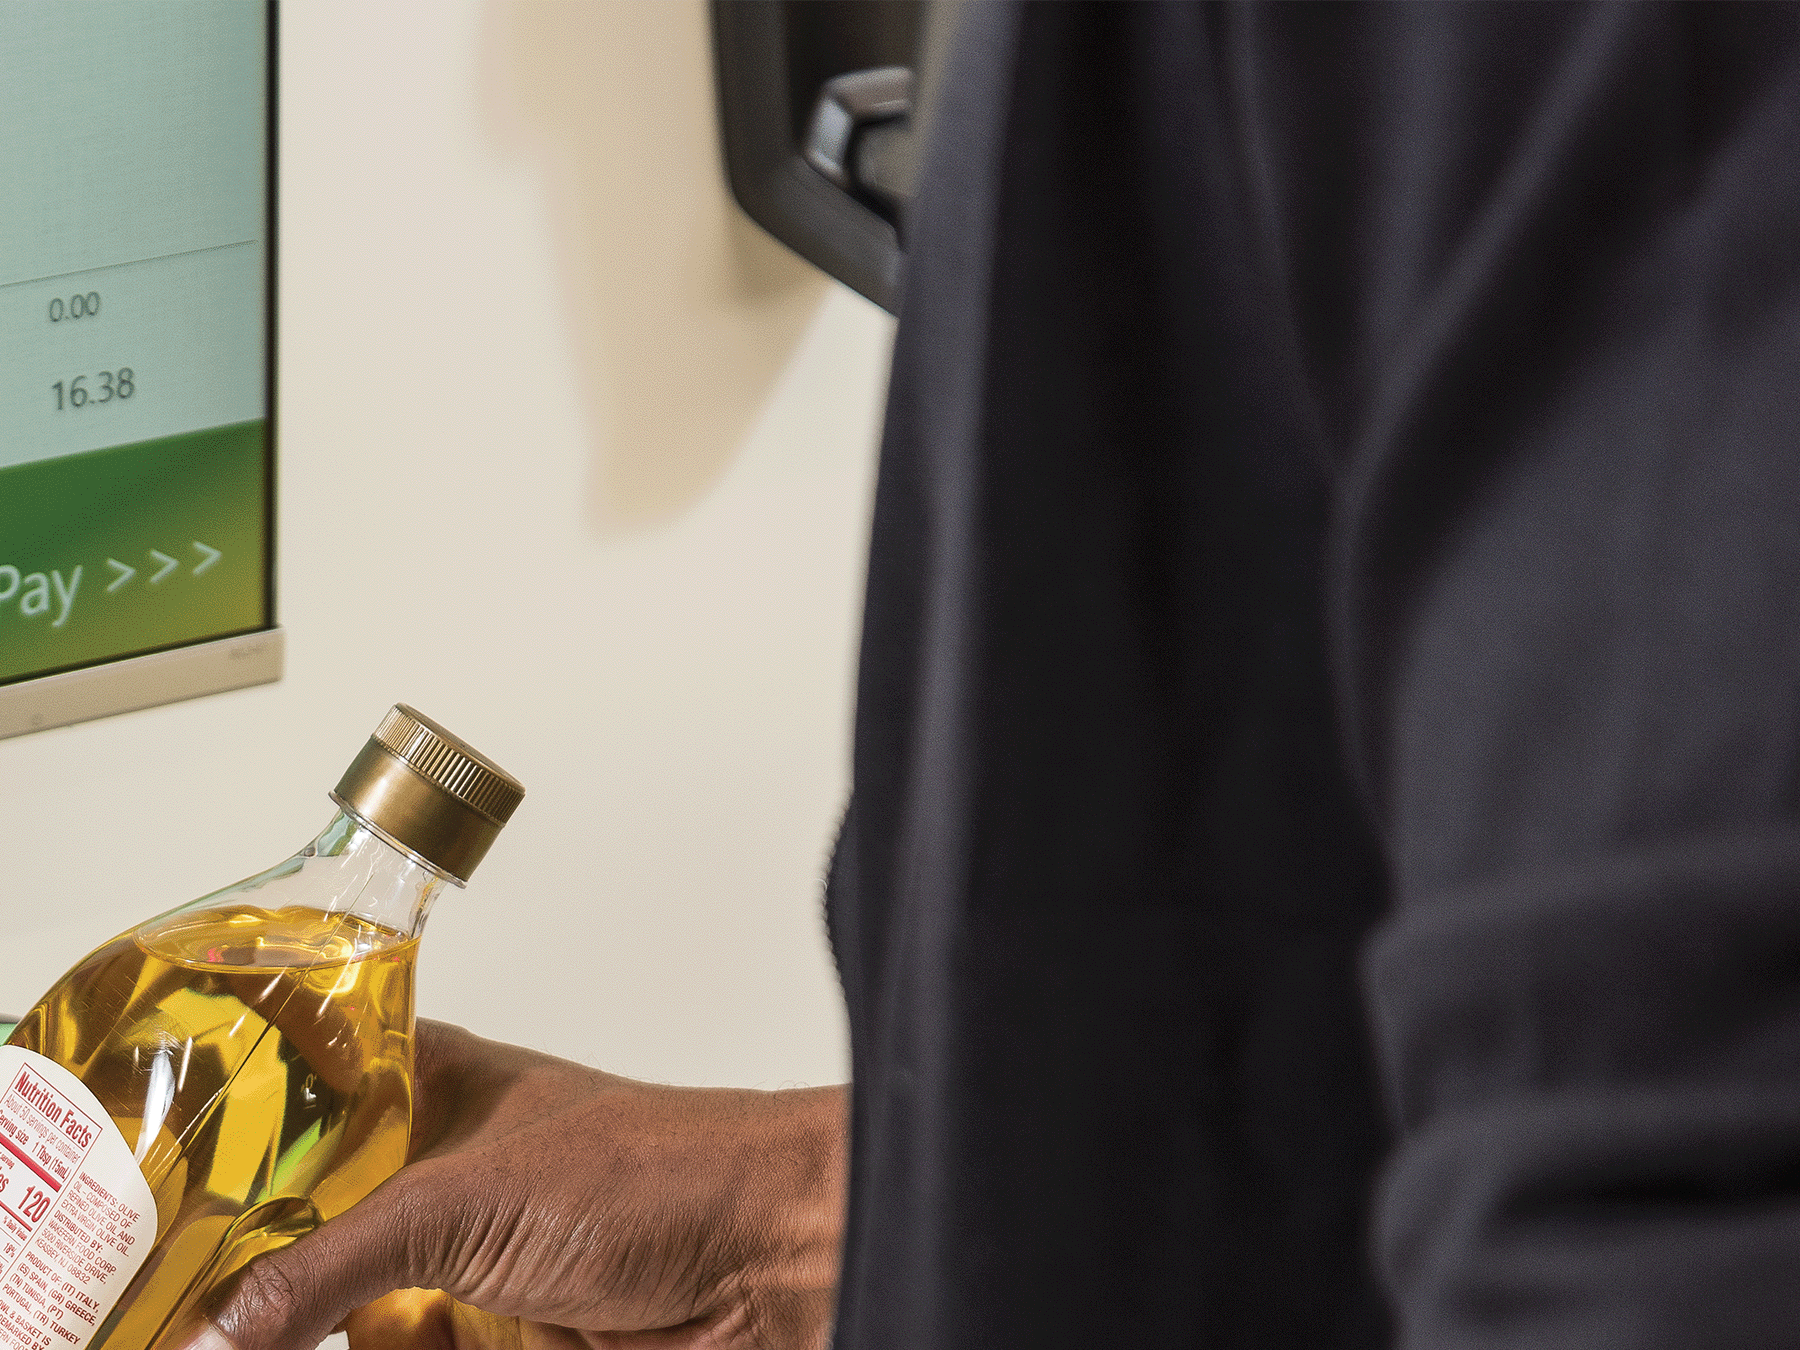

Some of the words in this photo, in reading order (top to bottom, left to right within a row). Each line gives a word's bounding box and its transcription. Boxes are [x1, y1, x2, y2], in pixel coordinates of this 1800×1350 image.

[48, 292, 101, 323] 0.00
[52, 367, 135, 412] 16.38
[4, 1093, 23, 1115] About
[18, 1105, 30, 1121] 50
[25, 1113, 50, 1139] servings
[45, 1132, 58, 1146] per
[55, 1138, 81, 1164] container
[14, 1071, 63, 1123] Nutrition
[59, 1109, 93, 1148] Facts
[15, 1128, 30, 1145] size
[35, 1144, 53, 1166] Tbsp
[47, 1156, 72, 1183] (15mL)
[17, 1185, 51, 1223] 120
[78, 1171, 119, 1208] INGREDIENTS:
[118, 1202, 141, 1223] OLIVE
[85, 1192, 121, 1222] COMPOSED
[119, 1218, 133, 1230] OF
[2, 1241, 16, 1258] 18%
[47, 1219, 76, 1246] WAKEFERN
[75, 1241, 95, 1260] FOOD
[94, 1255, 117, 1276] CORP.
[53, 1210, 91, 1244] DISTRIBUTED
[90, 1239, 103, 1254] BY:
[95, 1227, 118, 1247] OLIVE
[116, 1242, 130, 1257] OIL.
[105, 1221, 118, 1235] OIL
[117, 1229, 136, 1246] AND
[24, 1251, 53, 1276] PRODUCT
[50, 1272, 62, 1286] OF:
[61, 1281, 76, 1297] (IT)
[75, 1290, 101, 1314] ITALY,
[54, 1238, 86, 1267] RIVERSIDE
[83, 1262, 109, 1285] DRIVE,
[66, 1263, 91, 1285] 08832
[1, 1283, 33, 1314] PORTUGAL,
[32, 1309, 50, 1326] (TR)
[49, 1319, 81, 1346] TURKEY
[8, 1273, 24, 1288] (TN)
[21, 1282, 47, 1309] TUNISIA,
[46, 1304, 64, 1320] (PT)
[16, 1262, 30, 1277] (ES)
[27, 1271, 49, 1293] SPAIN,
[47, 1288, 65, 1305] (GR)
[64, 1299, 97, 1327] GREECE,
[14, 1315, 43, 1339] BASKET
